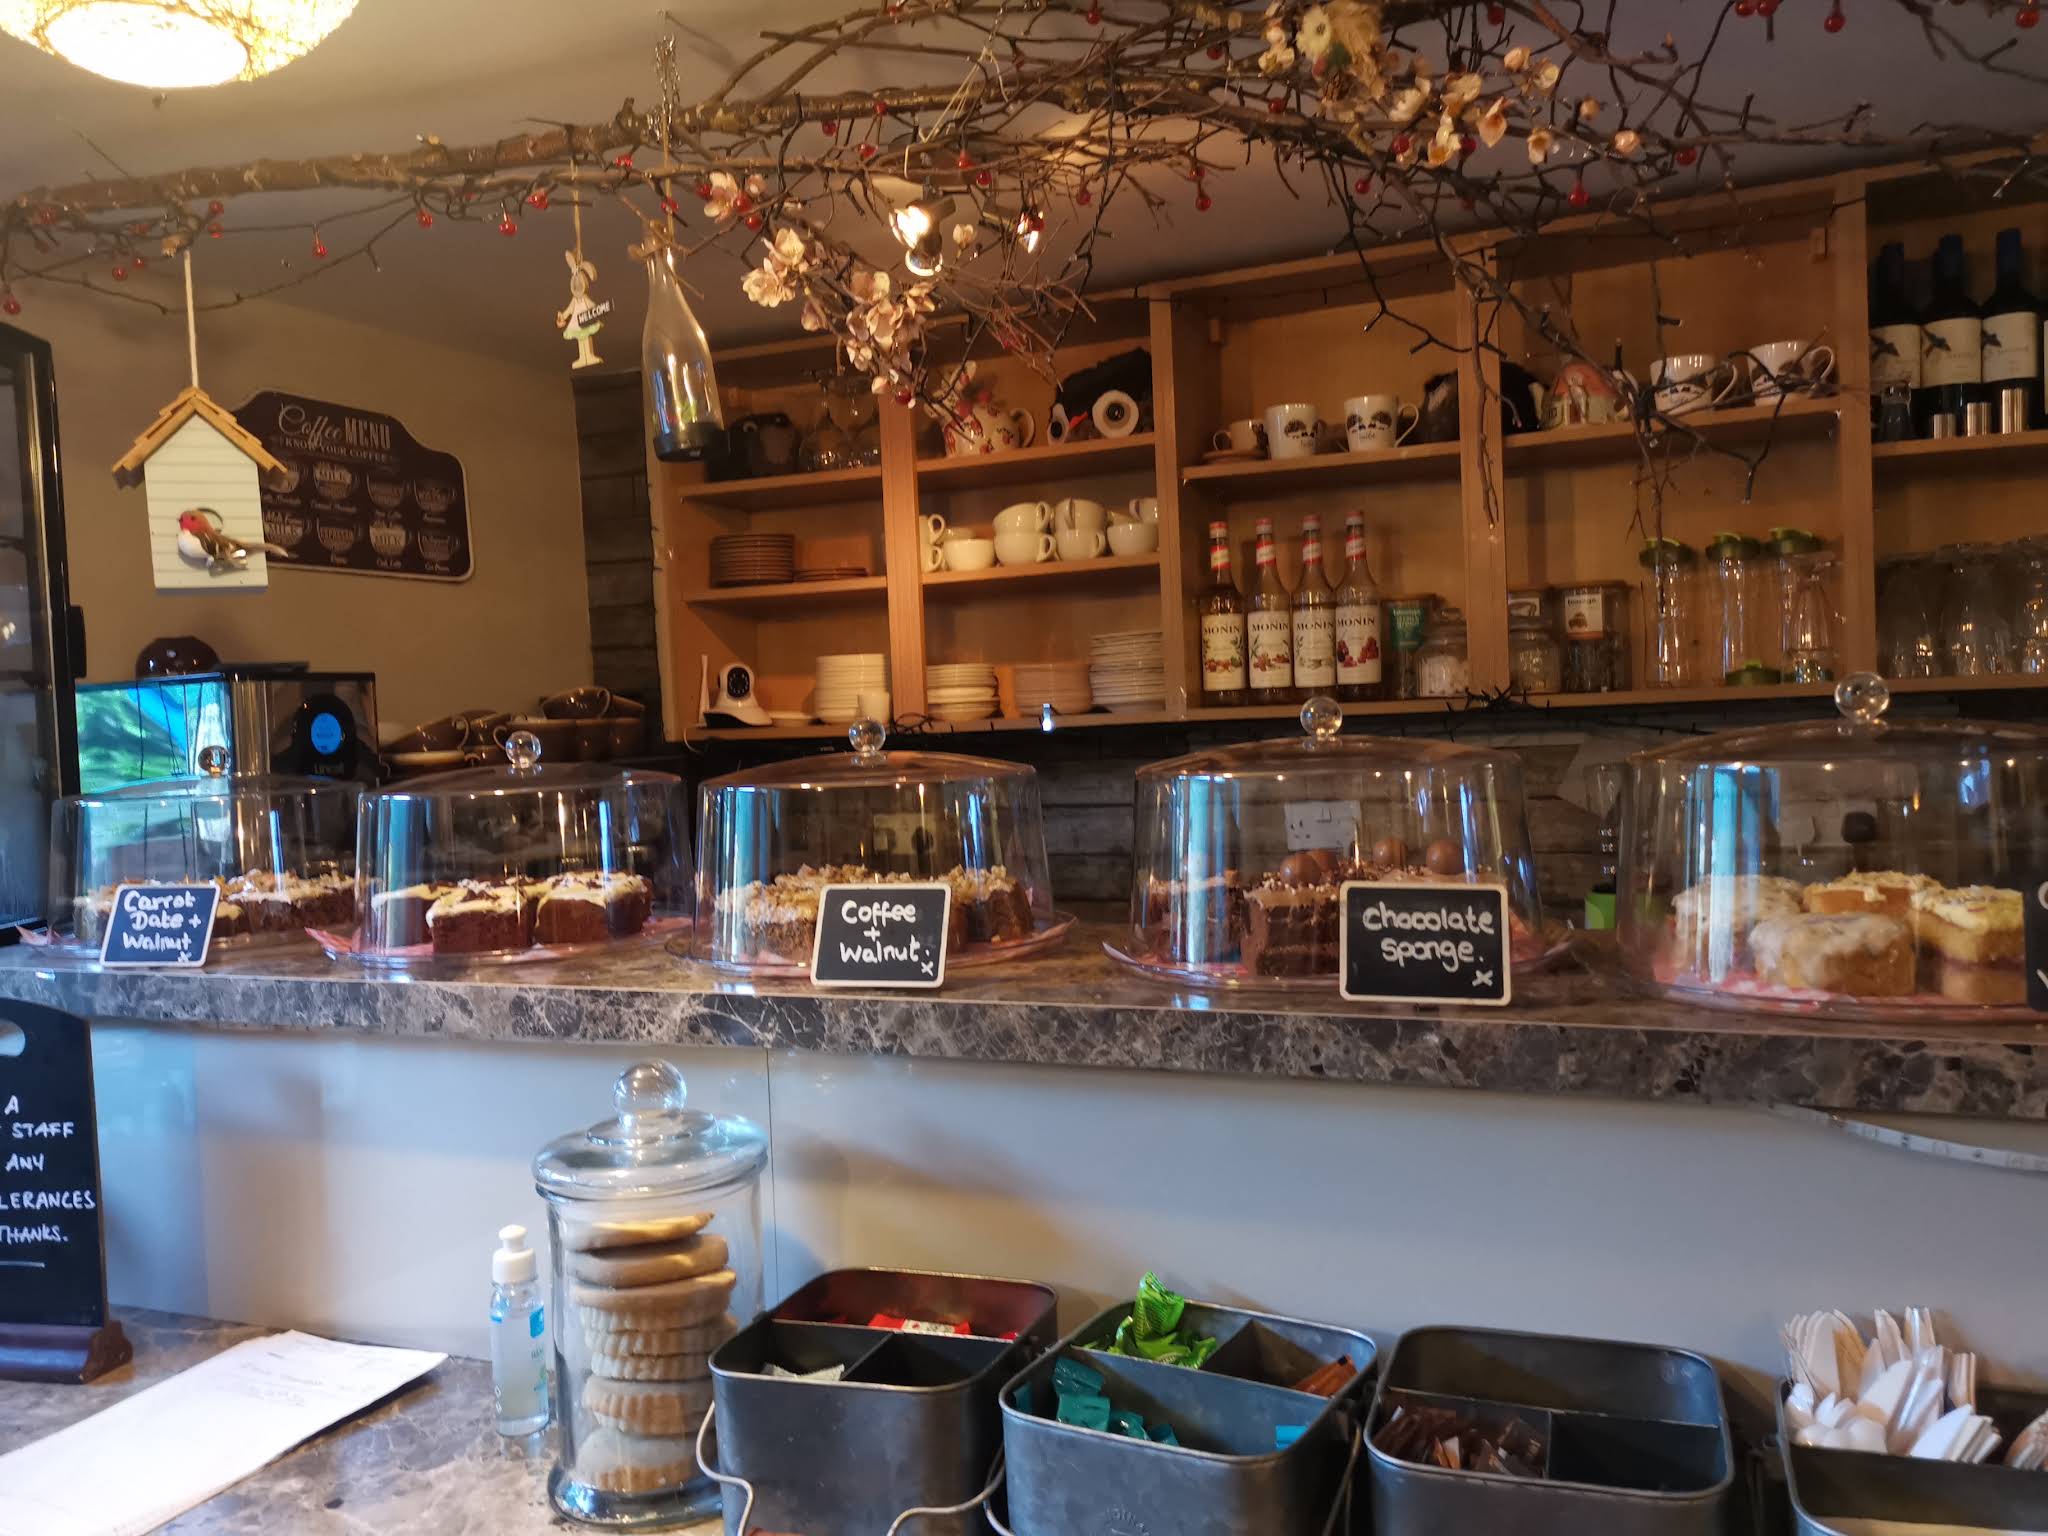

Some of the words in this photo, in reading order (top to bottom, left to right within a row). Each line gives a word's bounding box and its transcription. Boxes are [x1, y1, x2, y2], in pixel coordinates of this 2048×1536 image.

[578, 301, 611, 323] WELCOME
[279, 402, 341, 450] Coffee
[344, 416, 391, 449] MENU
[319, 444, 347, 457] YOUR
[349, 448, 386, 462] COFFEE
[1204, 624, 1241, 635] MONIN
[1252, 622, 1289, 633] MONIN
[1296, 621, 1334, 632] MONIN
[1337, 617, 1375, 627] MONIN
[124, 890, 196, 912] Carrot
[130, 910, 184, 931] Date
[188, 913, 202, 929] +
[841, 900, 917, 927] Coffee
[863, 926, 881, 942] +
[4, 1095, 20, 1115] A
[12, 1122, 74, 1139] STAFF
[5, 1153, 45, 1172] ANY
